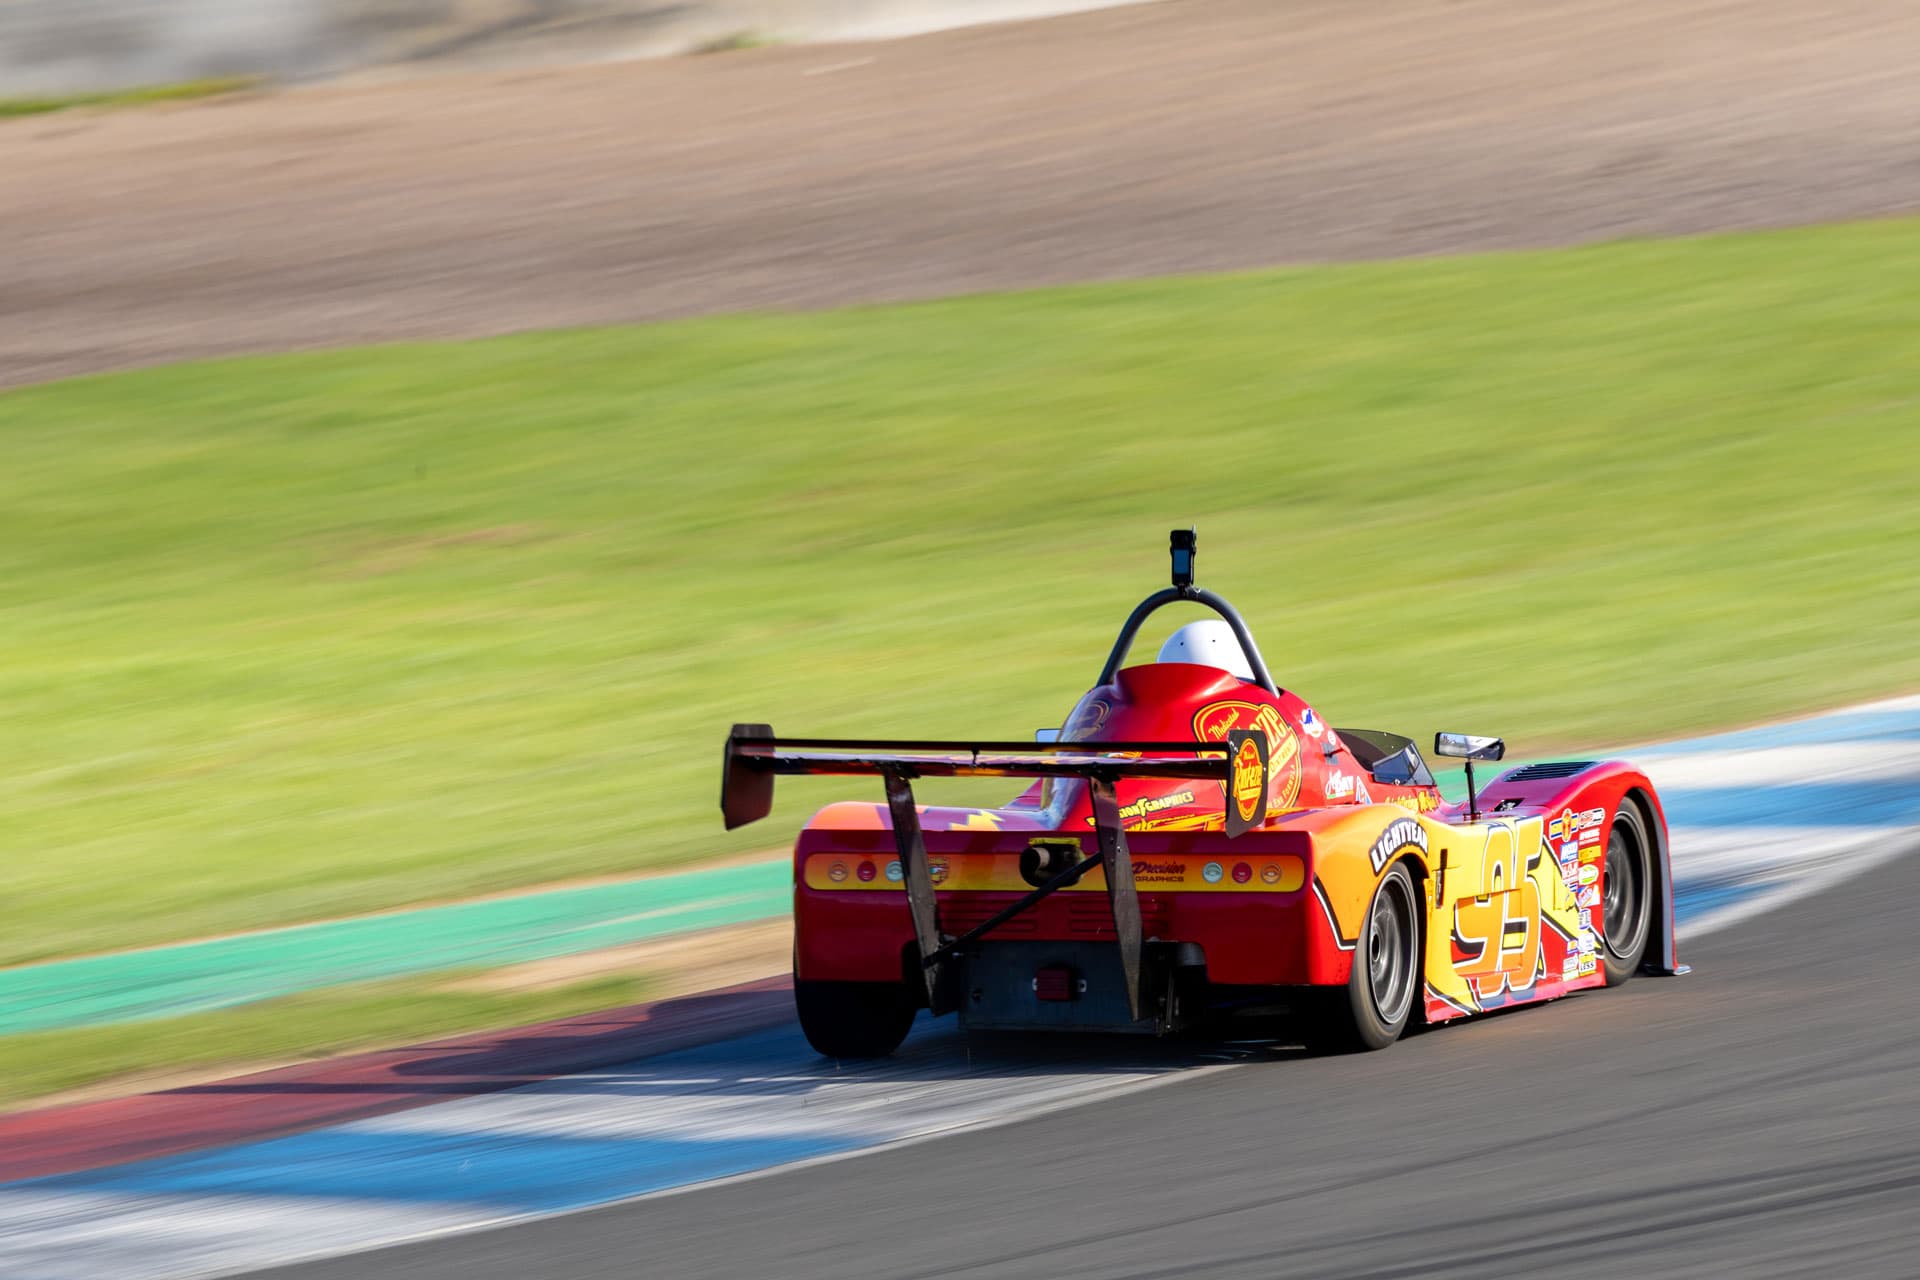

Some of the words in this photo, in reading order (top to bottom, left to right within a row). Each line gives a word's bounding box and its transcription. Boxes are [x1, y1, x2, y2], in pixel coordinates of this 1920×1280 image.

[1144, 791, 1194, 812] GRAPHICS
[1132, 861, 1186, 874] Precision
[1452, 815, 1544, 999] 95
